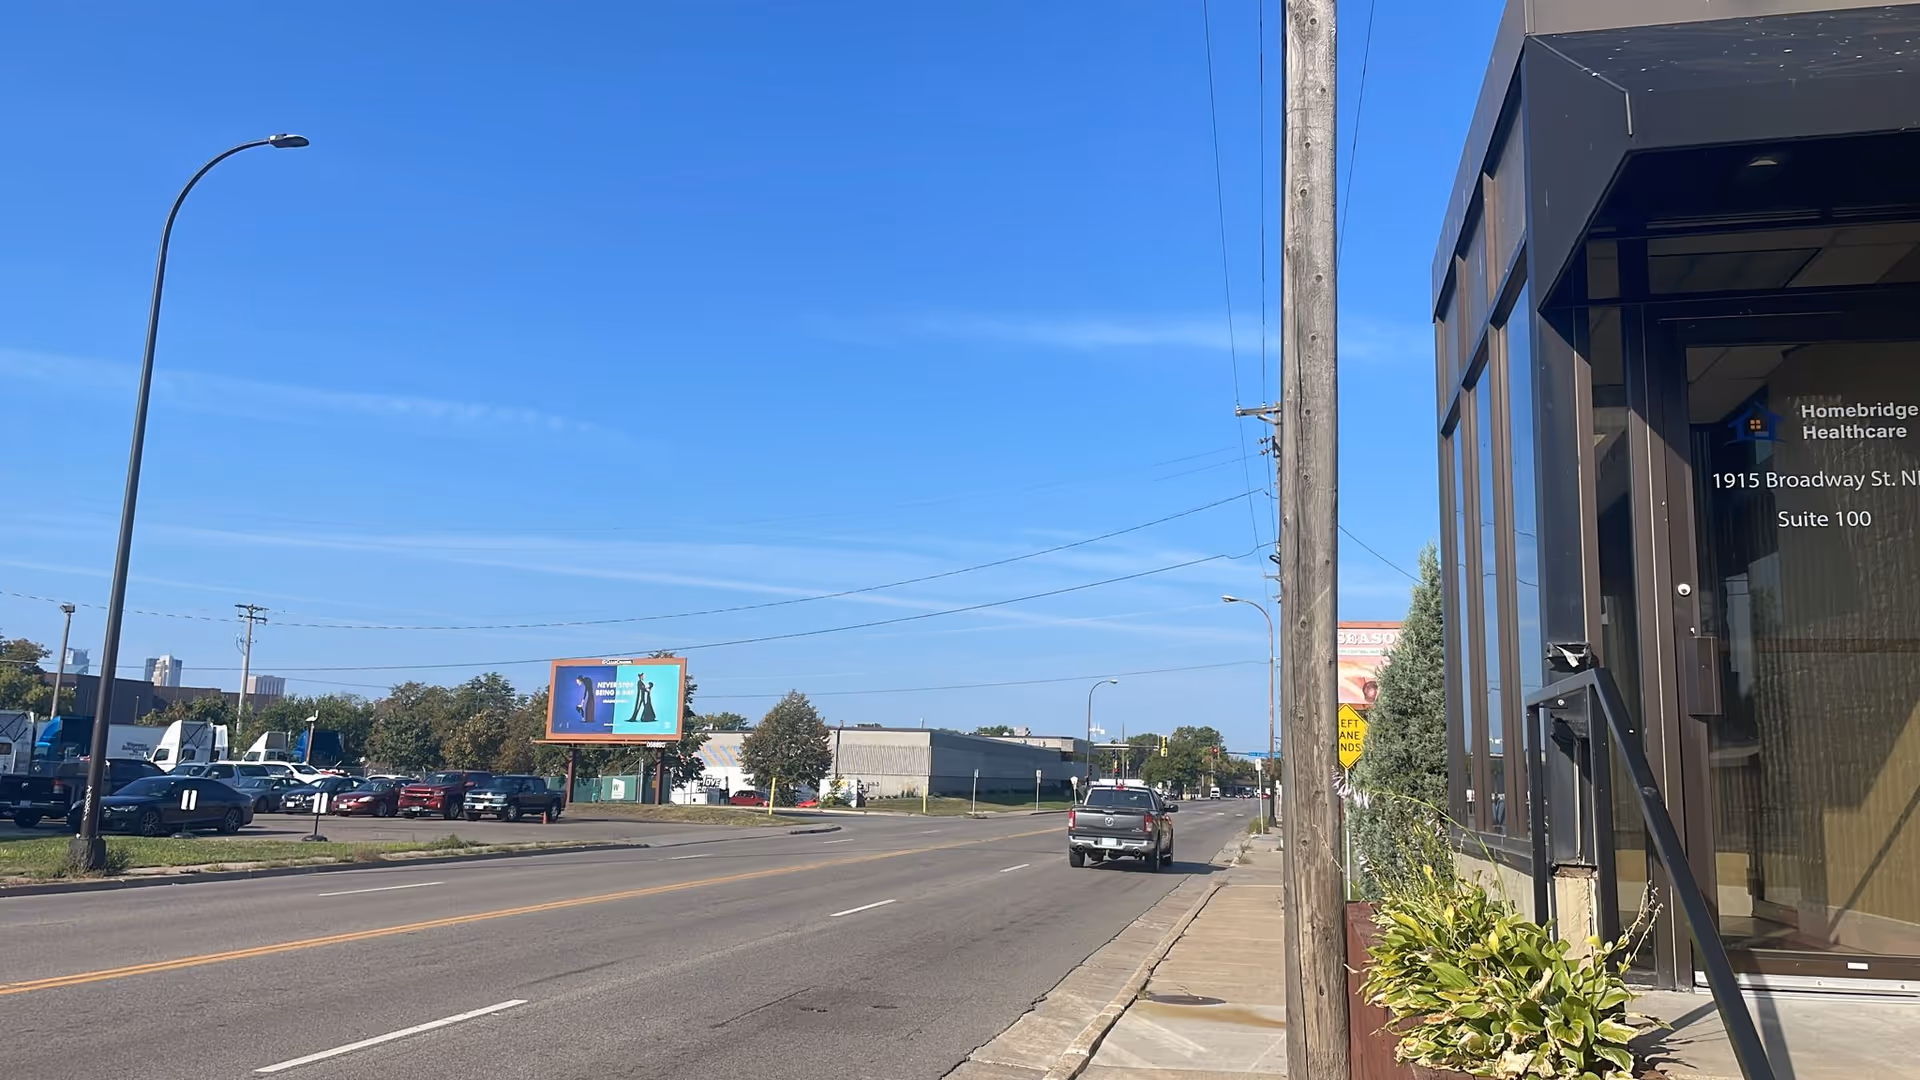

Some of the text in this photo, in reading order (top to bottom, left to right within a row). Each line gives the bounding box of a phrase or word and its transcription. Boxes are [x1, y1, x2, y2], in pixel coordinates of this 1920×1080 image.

[1801, 402, 1919, 420] Homebridge
[1803, 424, 1908, 440] Healthcare
[1713, 472, 1760, 489] 1915
[1766, 470, 1865, 491] Broadway
[1871, 470, 1896, 487] St.
[1778, 510, 1872, 527] Suite 100
[1338, 632, 1397, 645] SEASO
[1340, 719, 1359, 729] EFT
[1339, 731, 1361, 741] ANE
[1340, 743, 1361, 752] NDS
